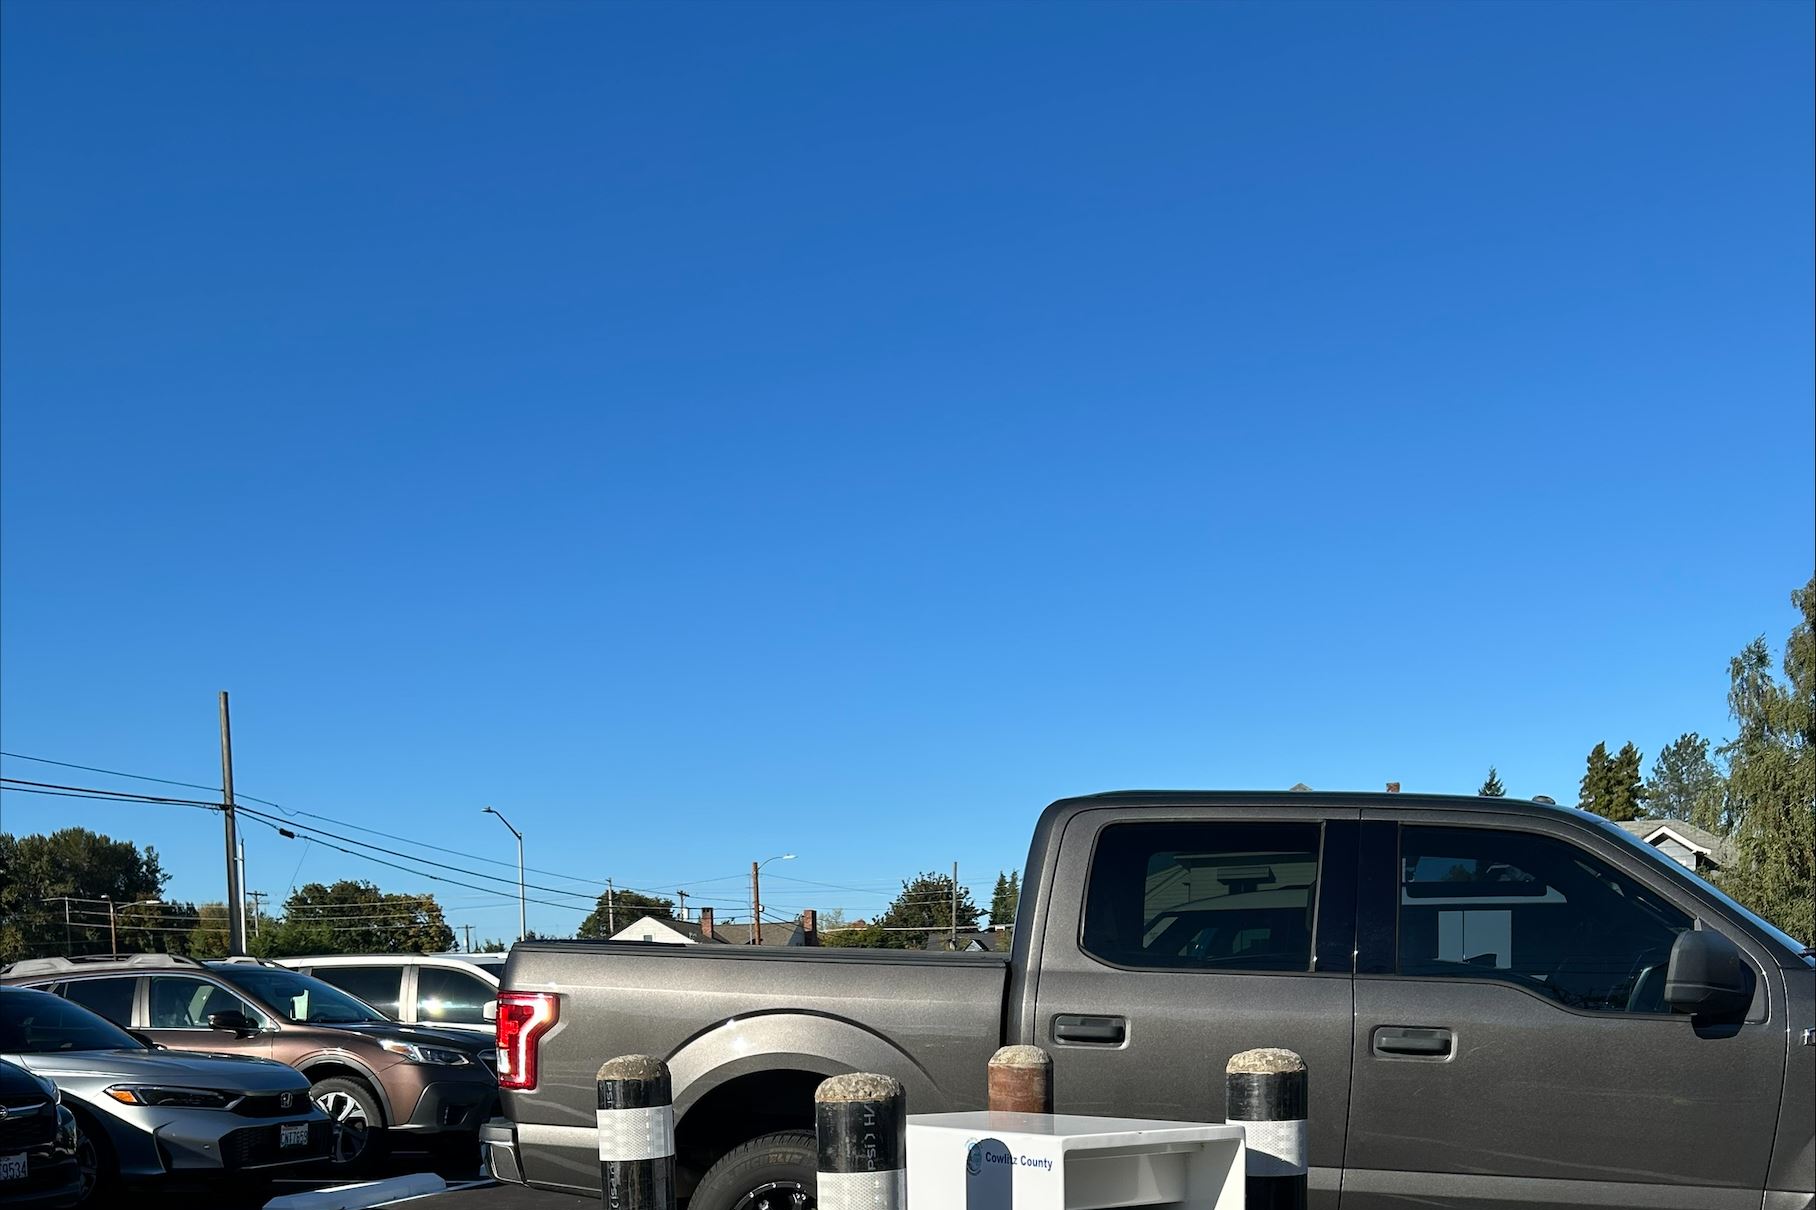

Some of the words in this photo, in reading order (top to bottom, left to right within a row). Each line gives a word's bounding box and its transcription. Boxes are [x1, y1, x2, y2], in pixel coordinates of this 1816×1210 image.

[0, 1160, 26, 1180] 9534
[985, 1151, 1017, 1165] Cowlitz
[1020, 1155, 1053, 1171] County
